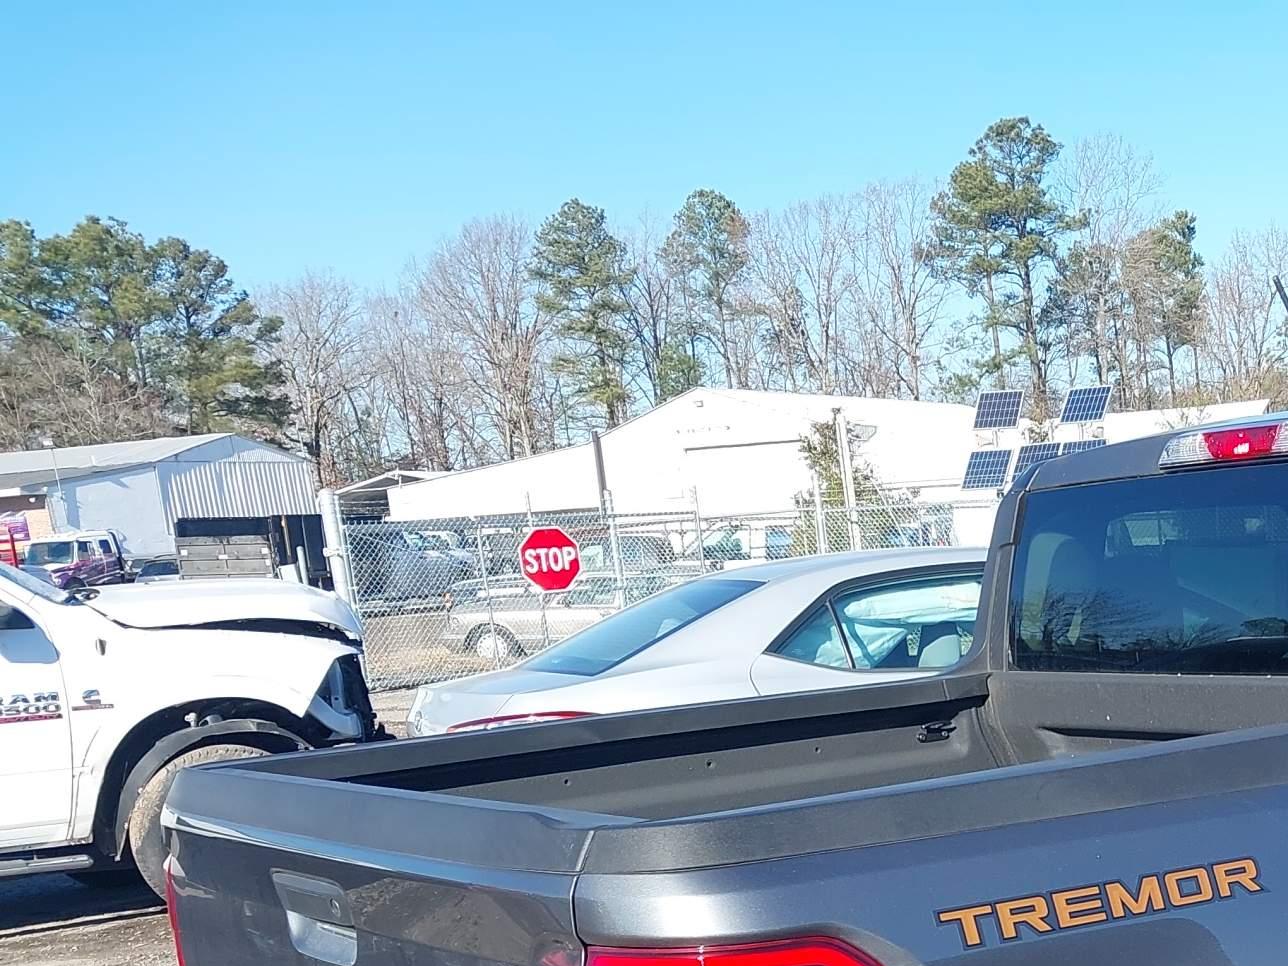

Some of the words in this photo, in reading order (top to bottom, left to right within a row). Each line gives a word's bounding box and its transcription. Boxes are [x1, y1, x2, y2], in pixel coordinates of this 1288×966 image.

[524, 546, 576, 573] STOP
[0, 692, 60, 705] AM
[0, 703, 61, 716] 500
[937, 857, 1263, 948] TREMOR
